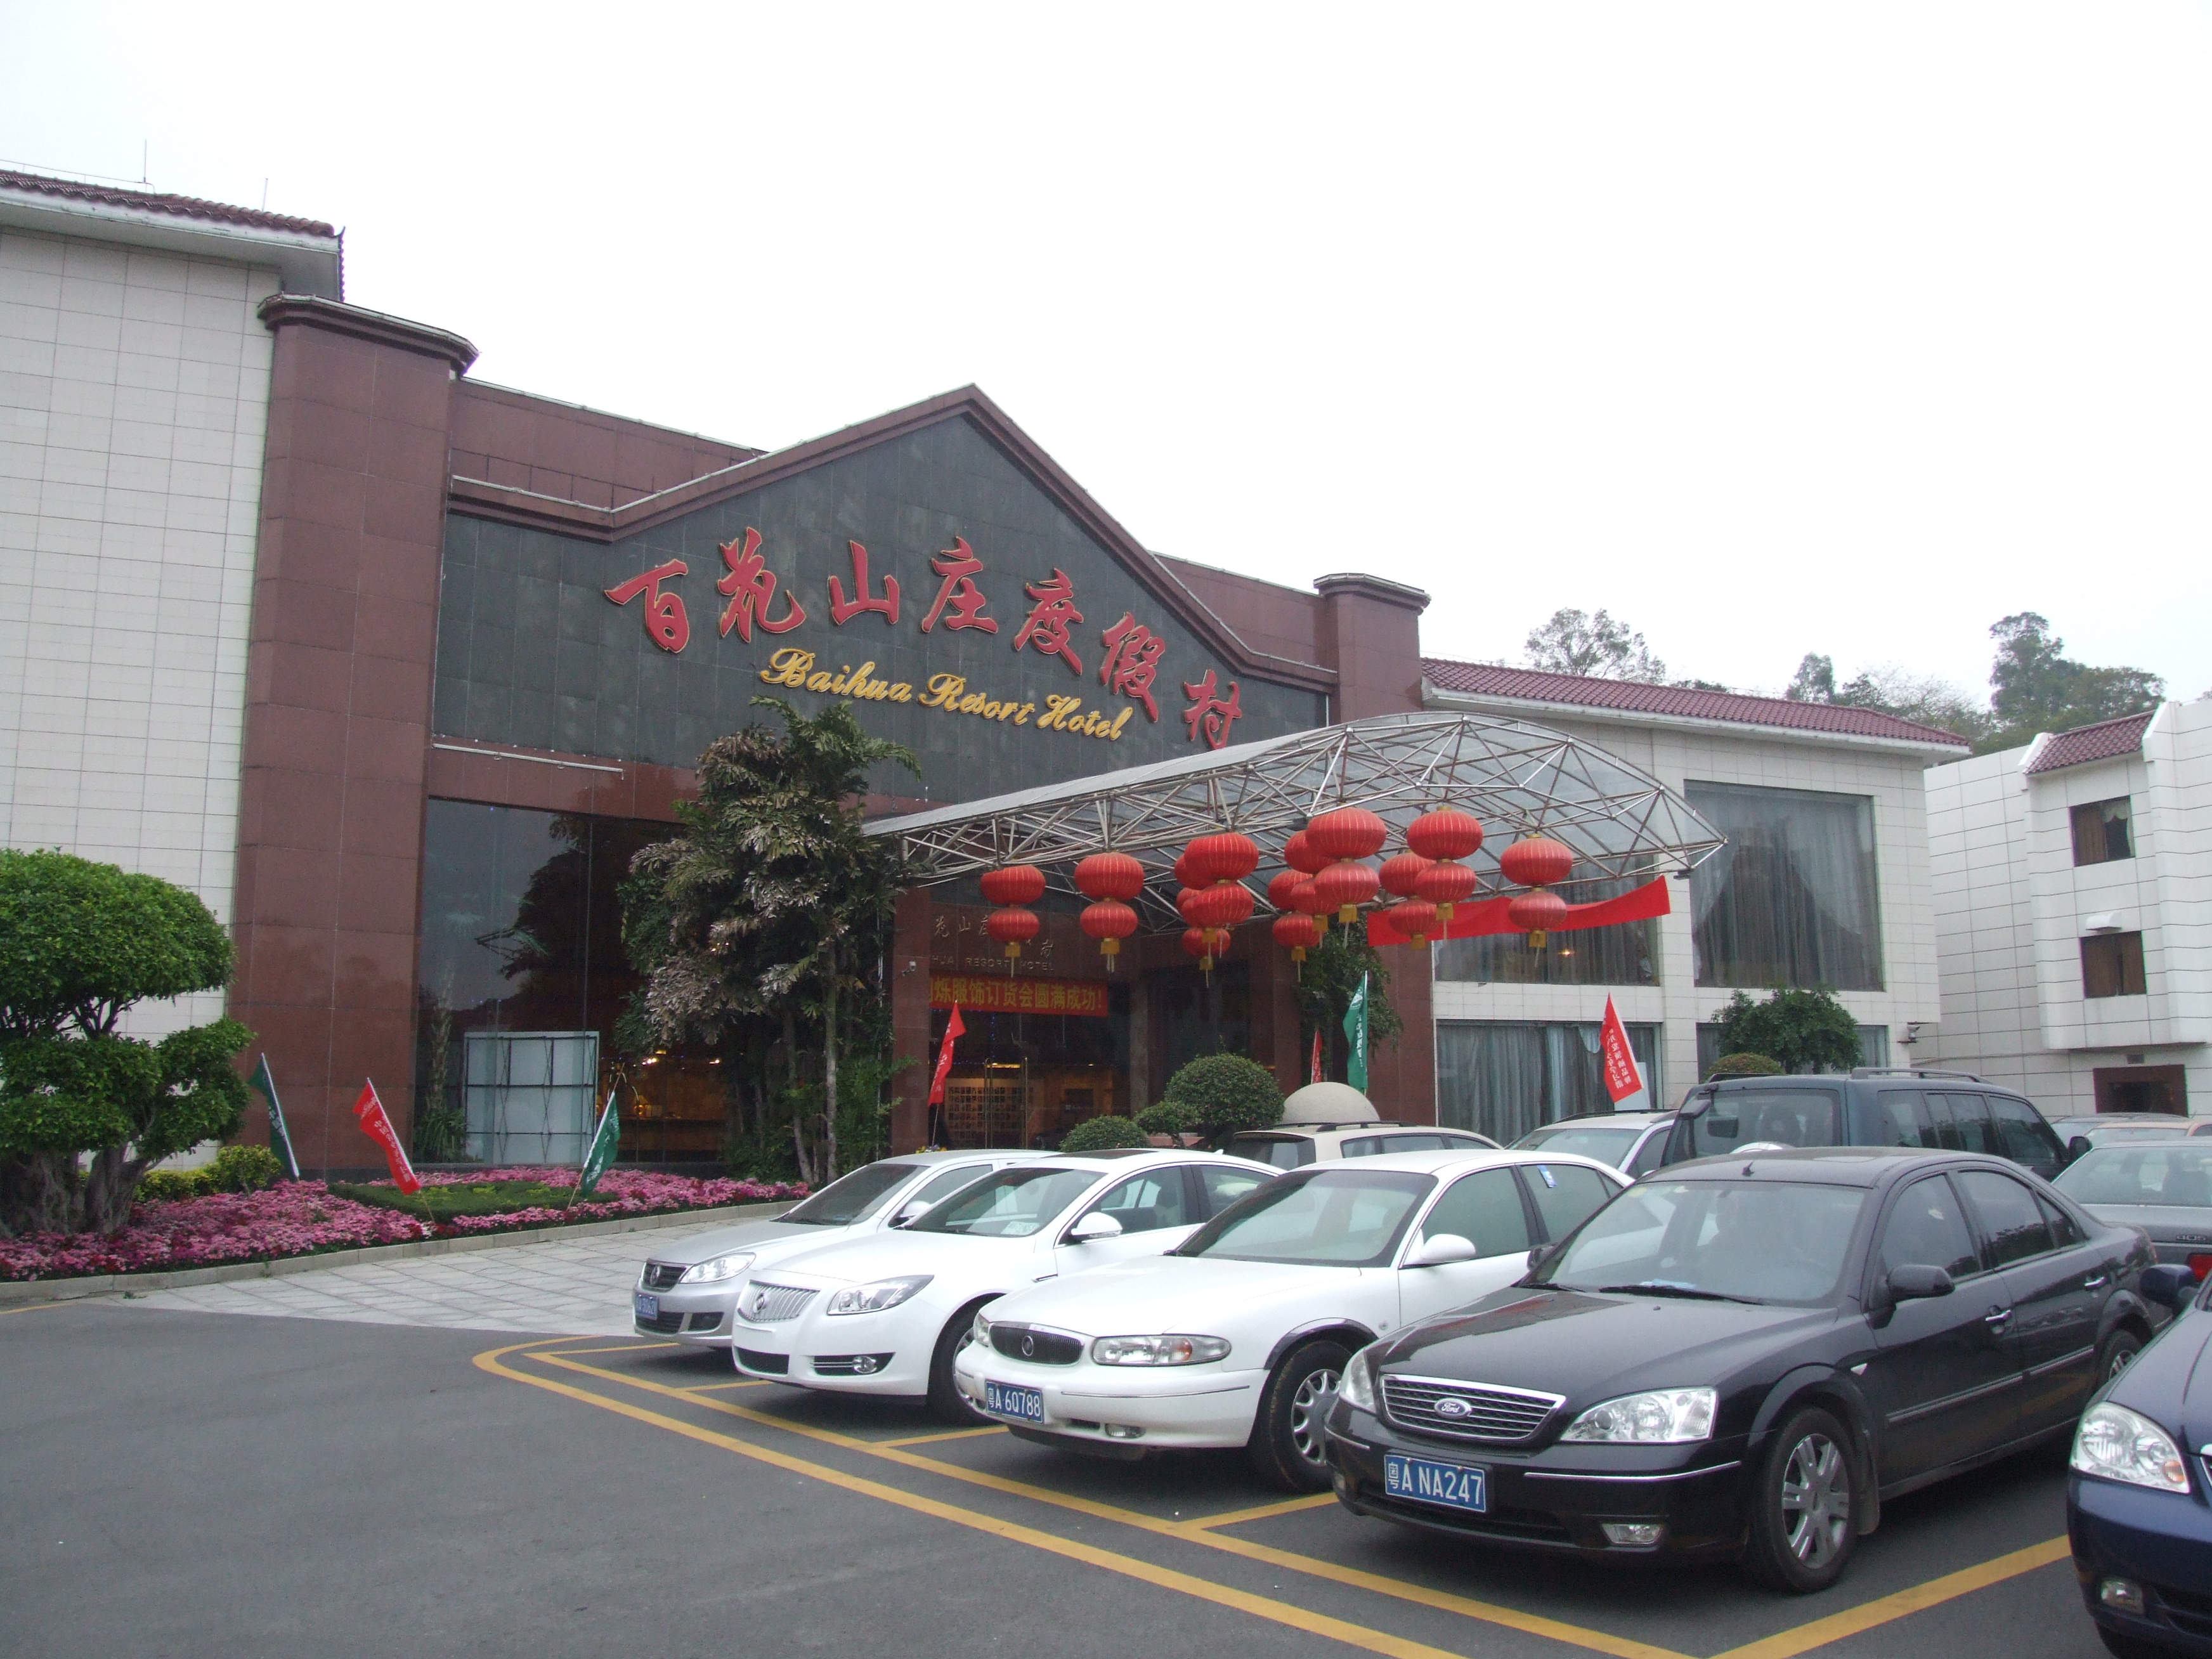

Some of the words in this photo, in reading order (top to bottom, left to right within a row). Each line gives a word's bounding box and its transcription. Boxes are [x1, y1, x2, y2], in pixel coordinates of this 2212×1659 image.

[604, 526, 1242, 750] 百花山庄度假村
[760, 647, 912, 702] Baihua
[918, 673, 1036, 725] Resort
[1037, 694, 1133, 741] Hotel
[1441, 1402, 1460, 1413] Ford
